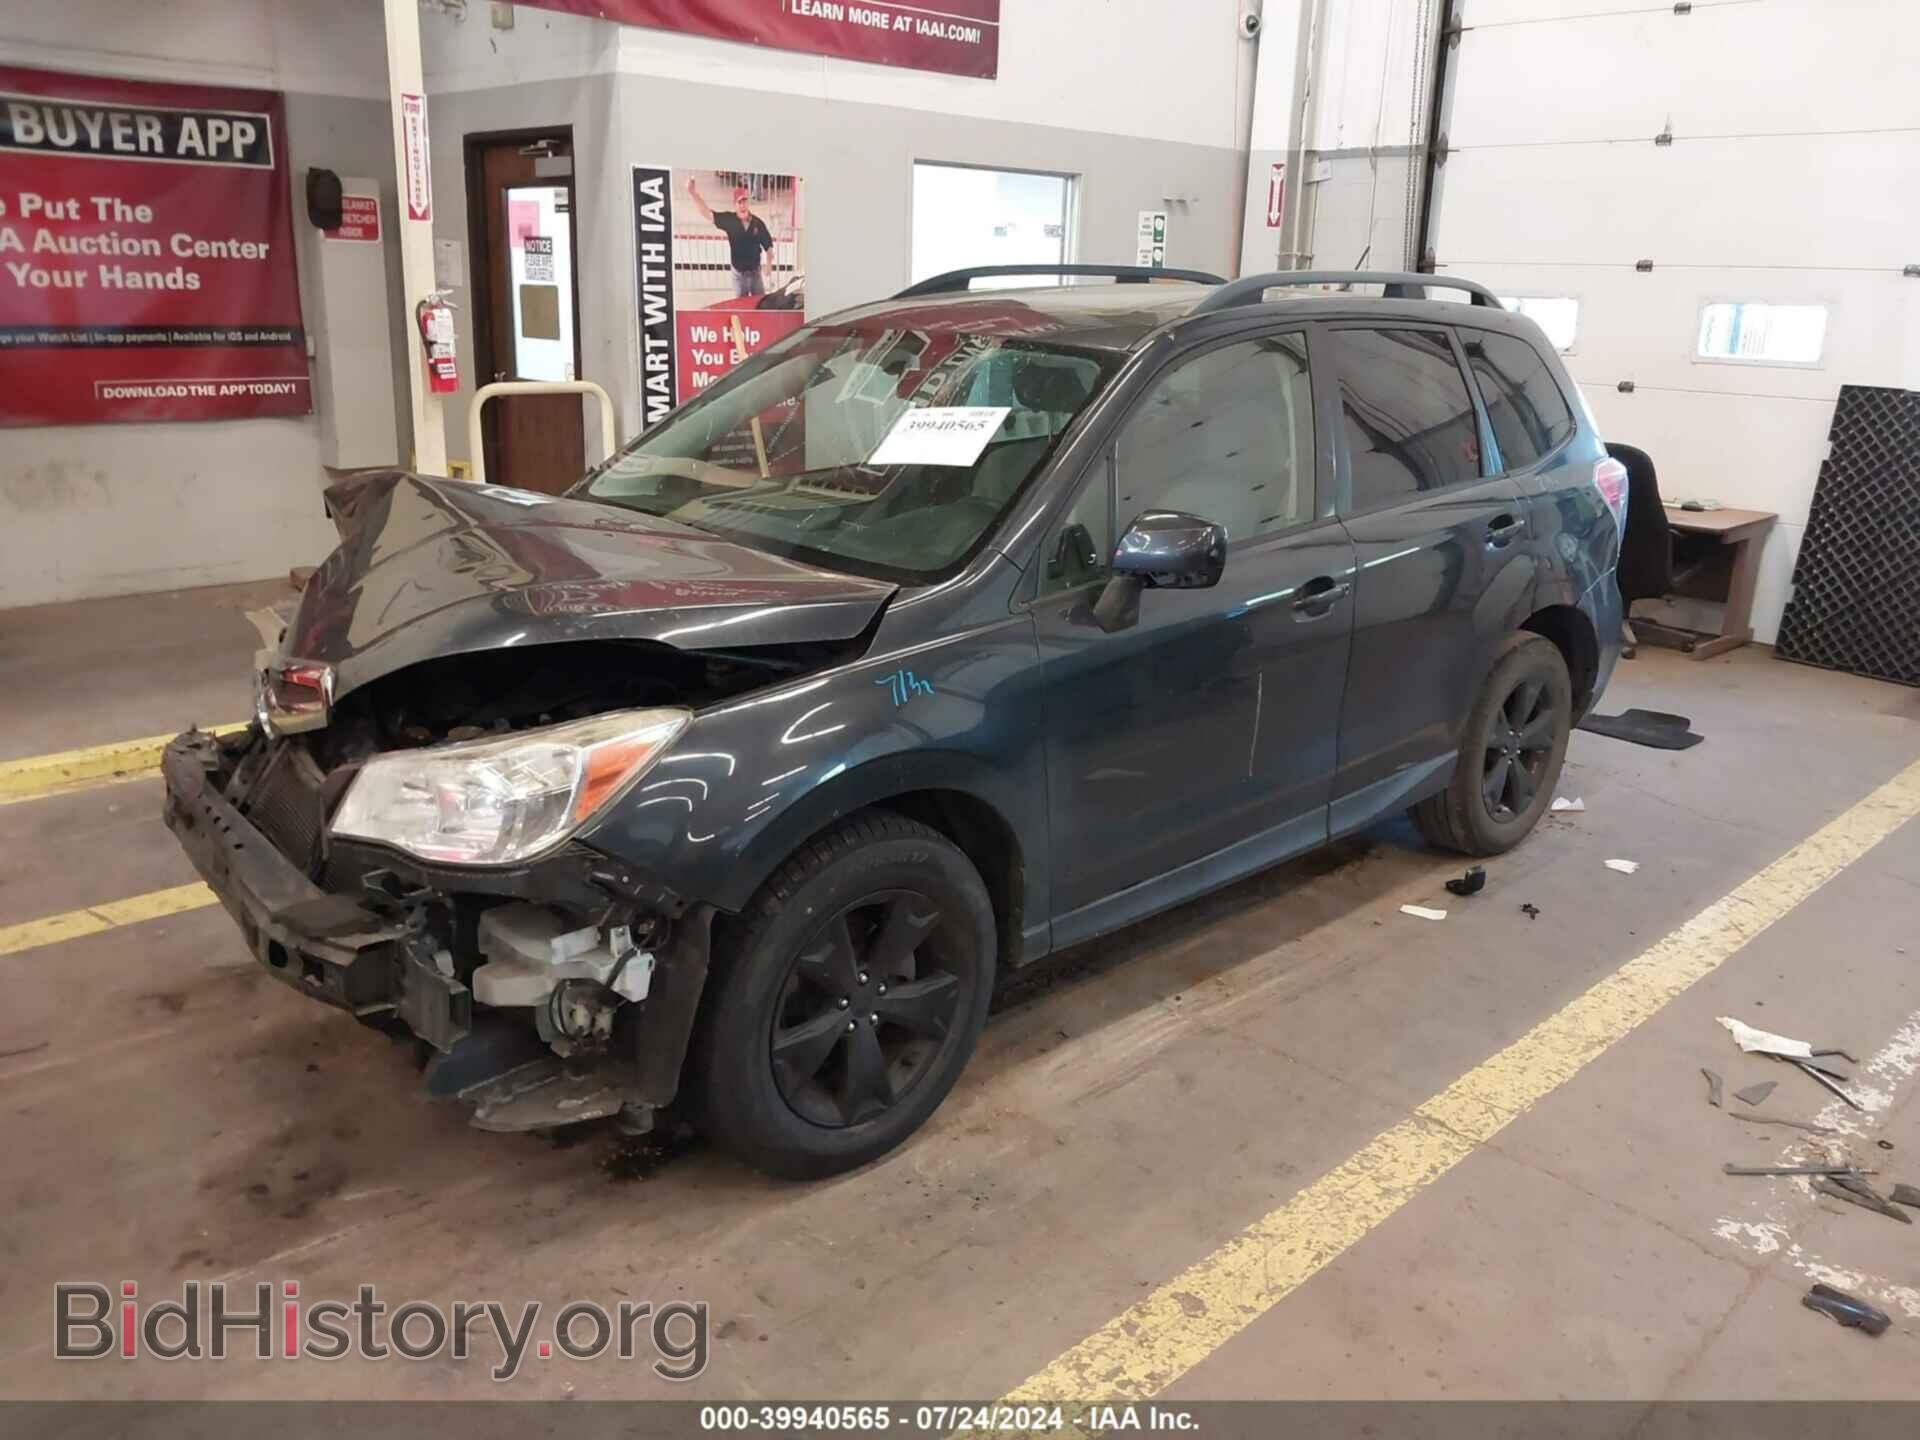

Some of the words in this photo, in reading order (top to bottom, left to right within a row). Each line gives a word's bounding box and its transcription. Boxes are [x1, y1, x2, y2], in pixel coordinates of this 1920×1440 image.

[791, 0, 843, 21] LEARN
[848, 7, 889, 29] MORE
[893, 15, 912, 32] AT
[916, 18, 981, 44] IAAI.COM!
[8, 102, 164, 153] BUYER
[177, 117, 256, 158] APP
[19, 192, 81, 220] Put
[90, 196, 153, 223] The
[640, 176, 665, 232] IAA
[33, 229, 162, 257] Auction
[170, 233, 270, 260] Center
[6, 262, 88, 289] Your
[99, 264, 201, 290] Hands
[642, 243, 668, 326] WITH
[690, 325, 718, 343] We
[691, 348, 724, 366] You
[103, 386, 188, 399] DOWNLOAD
[188, 385, 216, 397] THE
[219, 384, 248, 396] APP
[248, 383, 297, 395] TODAY!
